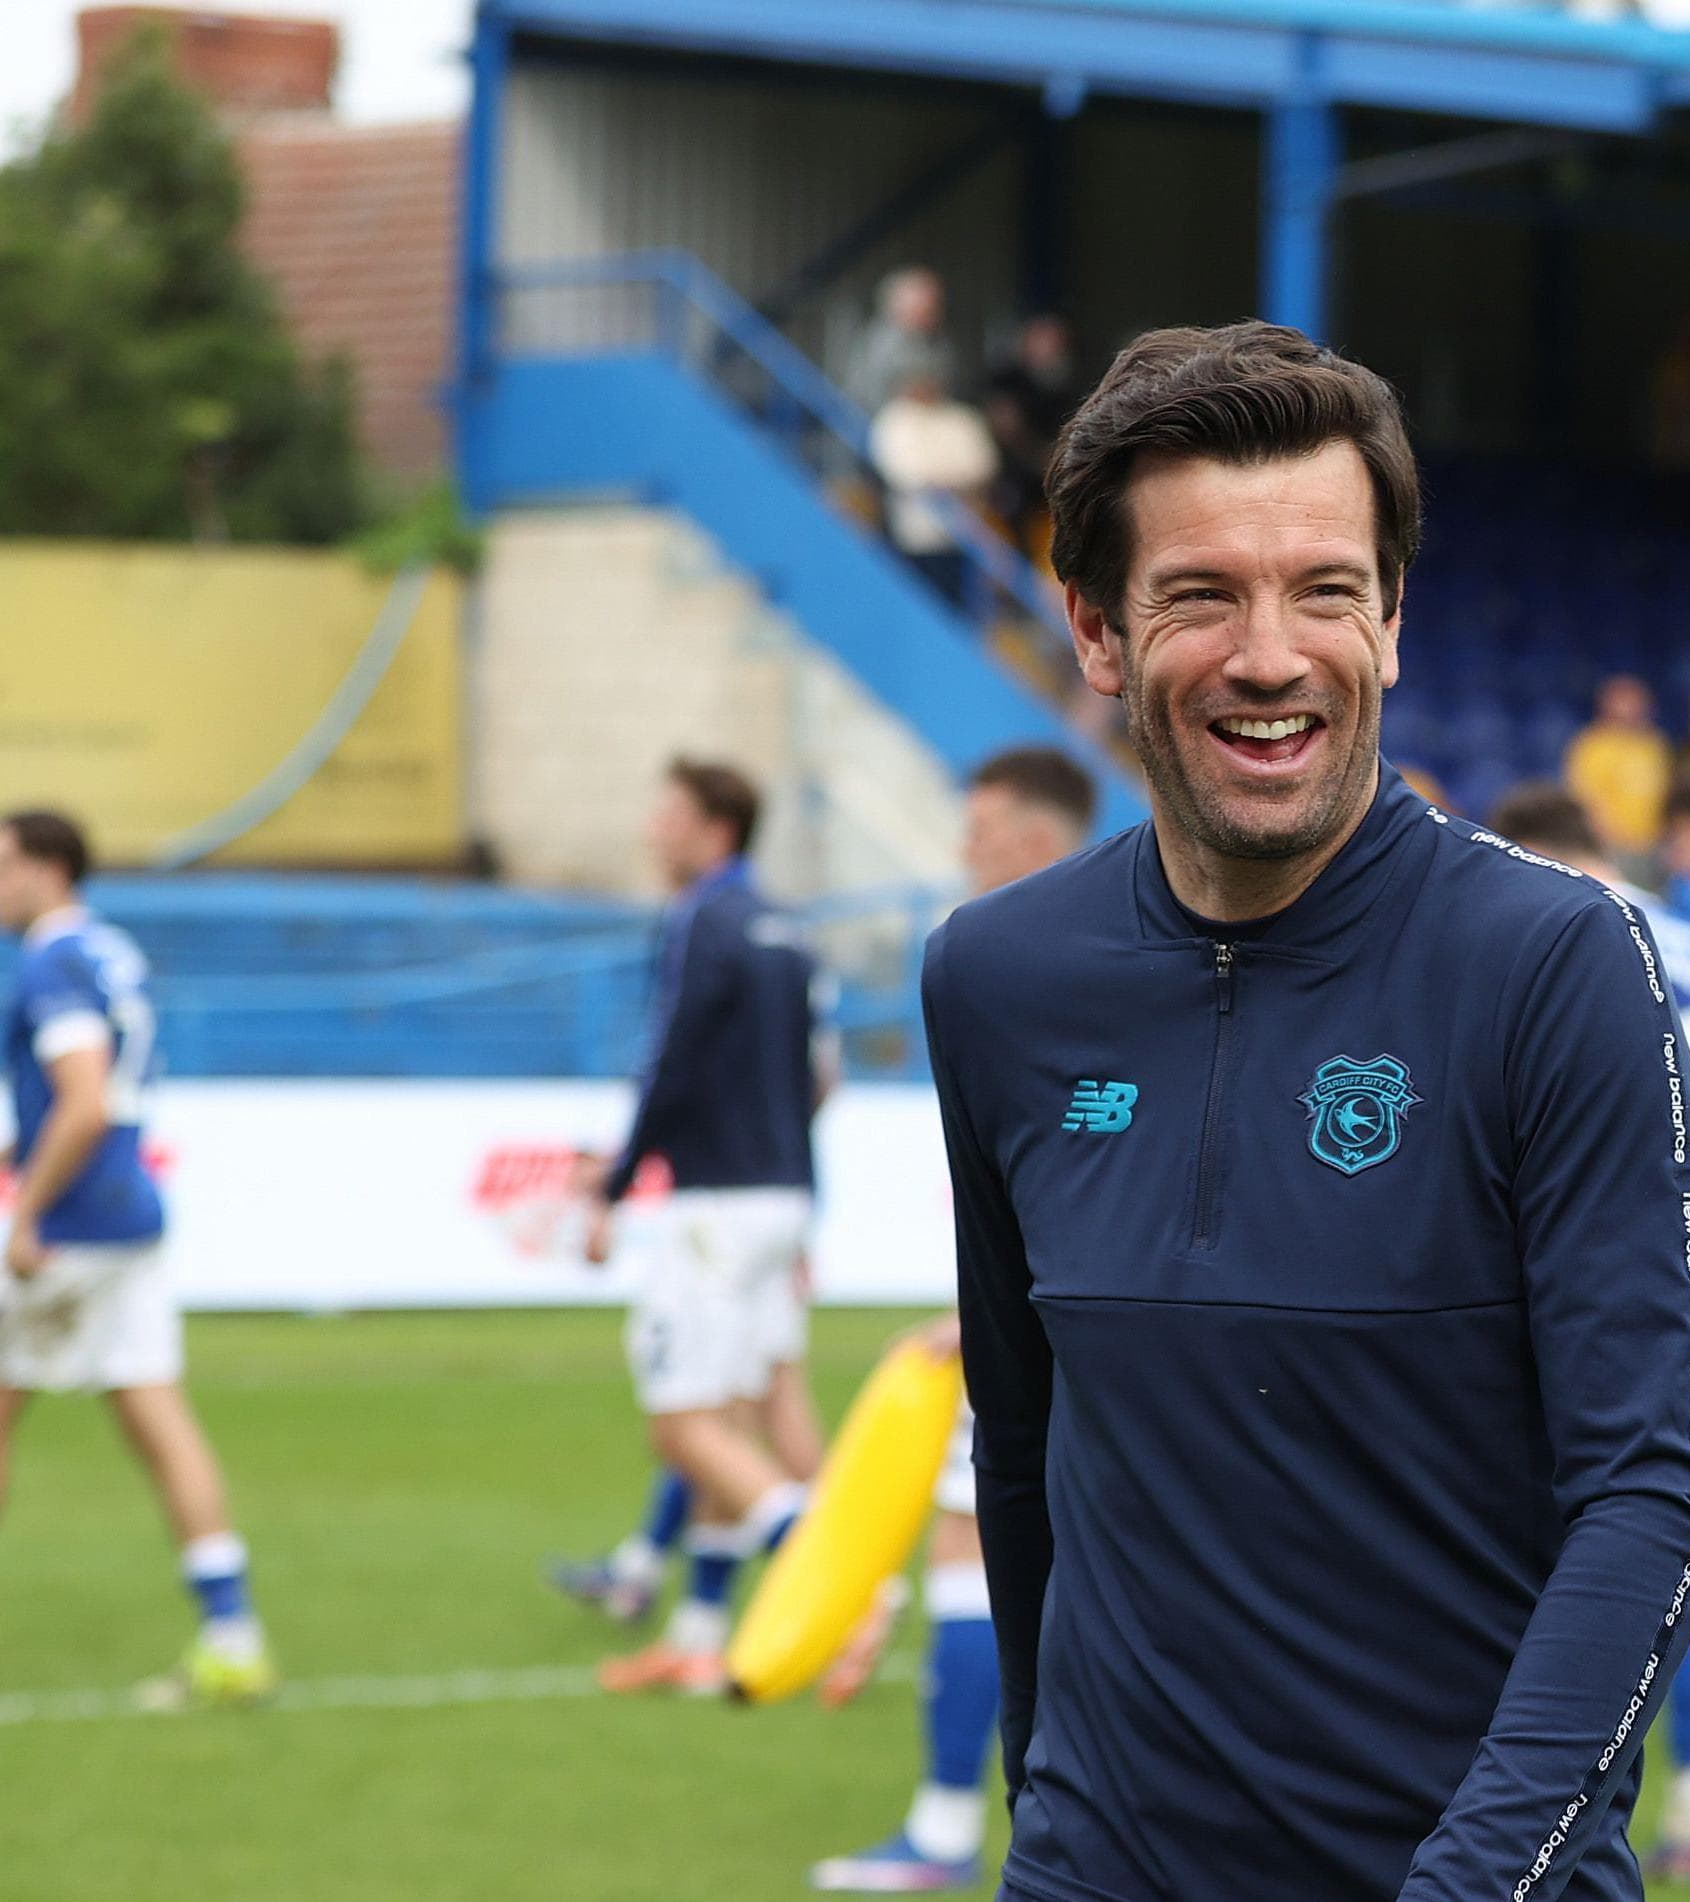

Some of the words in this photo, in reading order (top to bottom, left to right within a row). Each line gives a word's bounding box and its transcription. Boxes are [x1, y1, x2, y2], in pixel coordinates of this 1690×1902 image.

[1470, 831, 1511, 850] new
[1602, 889, 1637, 923] new
[1629, 925, 1665, 1004] balance
[1663, 1032, 1678, 1075] new
[1318, 1076, 1361, 1094] CARDIFF
[1362, 1076, 1386, 1087] CITY
[1385, 1082, 1400, 1094] FC
[1668, 1077, 1686, 1164] balance
[1637, 1653, 1660, 1697] new
[1598, 1695, 1644, 1771] balance
[1558, 1793, 1589, 1834] new
[1513, 1830, 1566, 1902] balance
